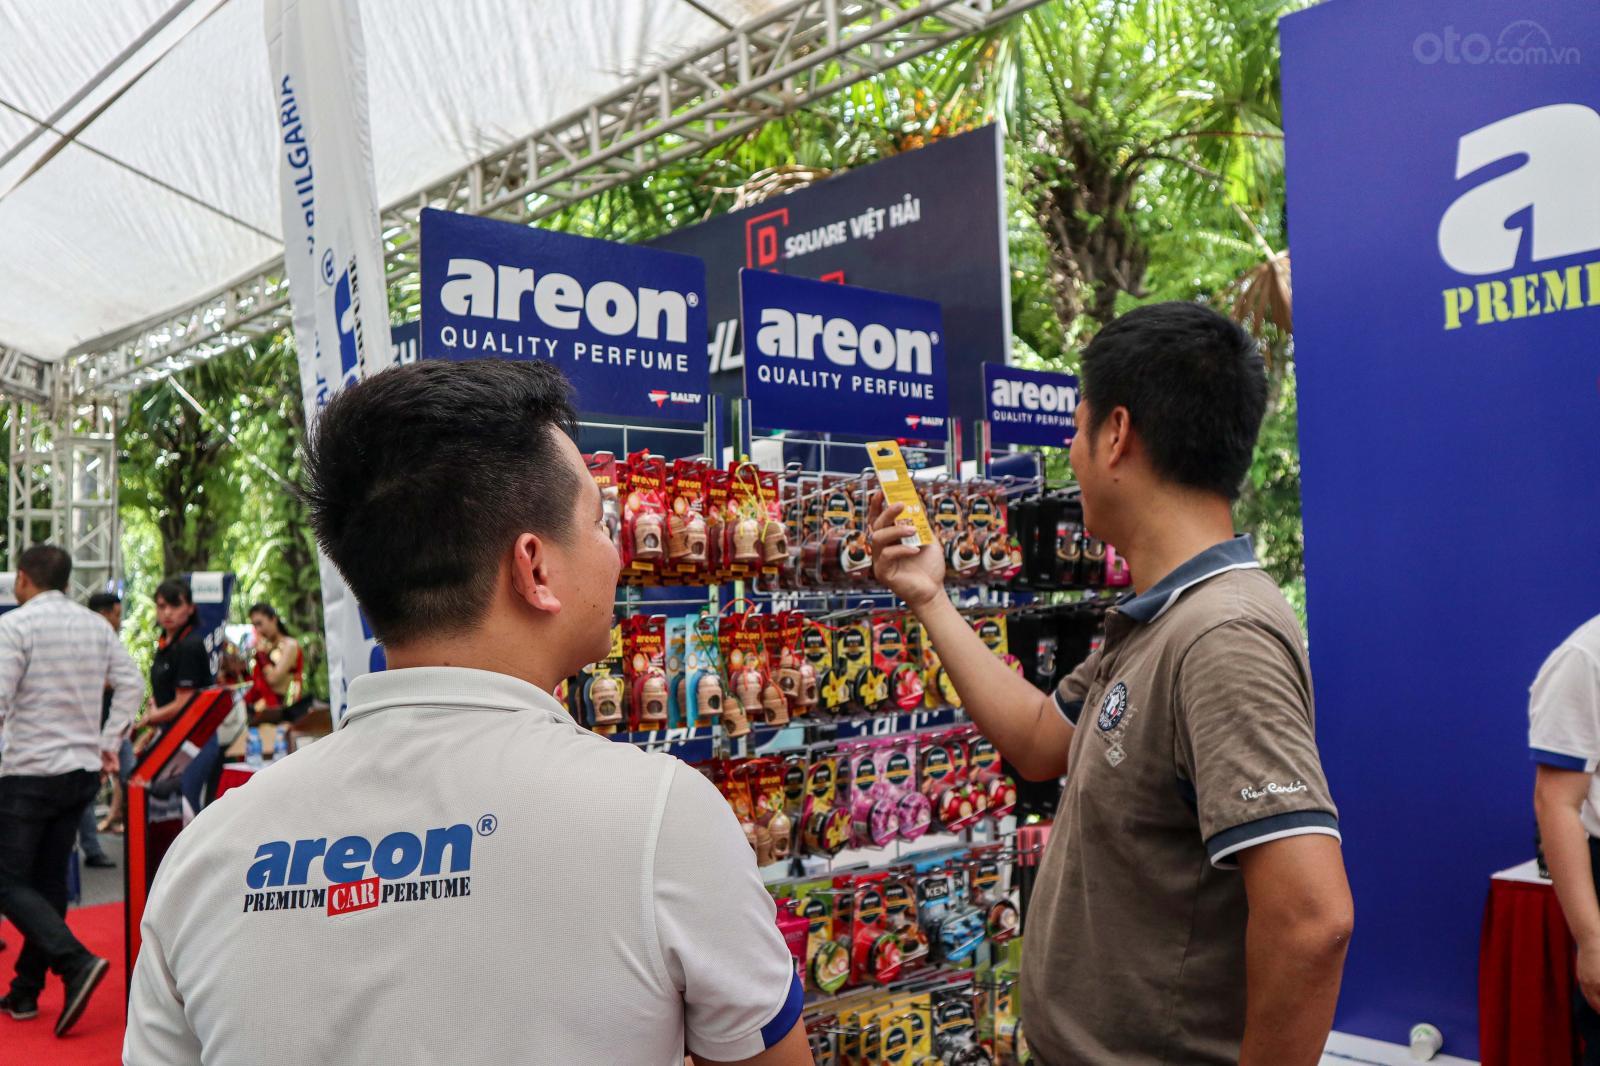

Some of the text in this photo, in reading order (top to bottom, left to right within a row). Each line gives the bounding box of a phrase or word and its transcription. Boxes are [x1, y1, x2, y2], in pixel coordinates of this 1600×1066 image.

[784, 220, 847, 260] SQUARE
[849, 207, 886, 240] VIỆT
[440, 326, 559, 357] QUALITY
[574, 341, 689, 373] PERFUME
[757, 364, 935, 400] QUALITY PERFUME
[993, 410, 1033, 424] QUALITY
[243, 876, 471, 913] PREMIUM CAR PERFUME
